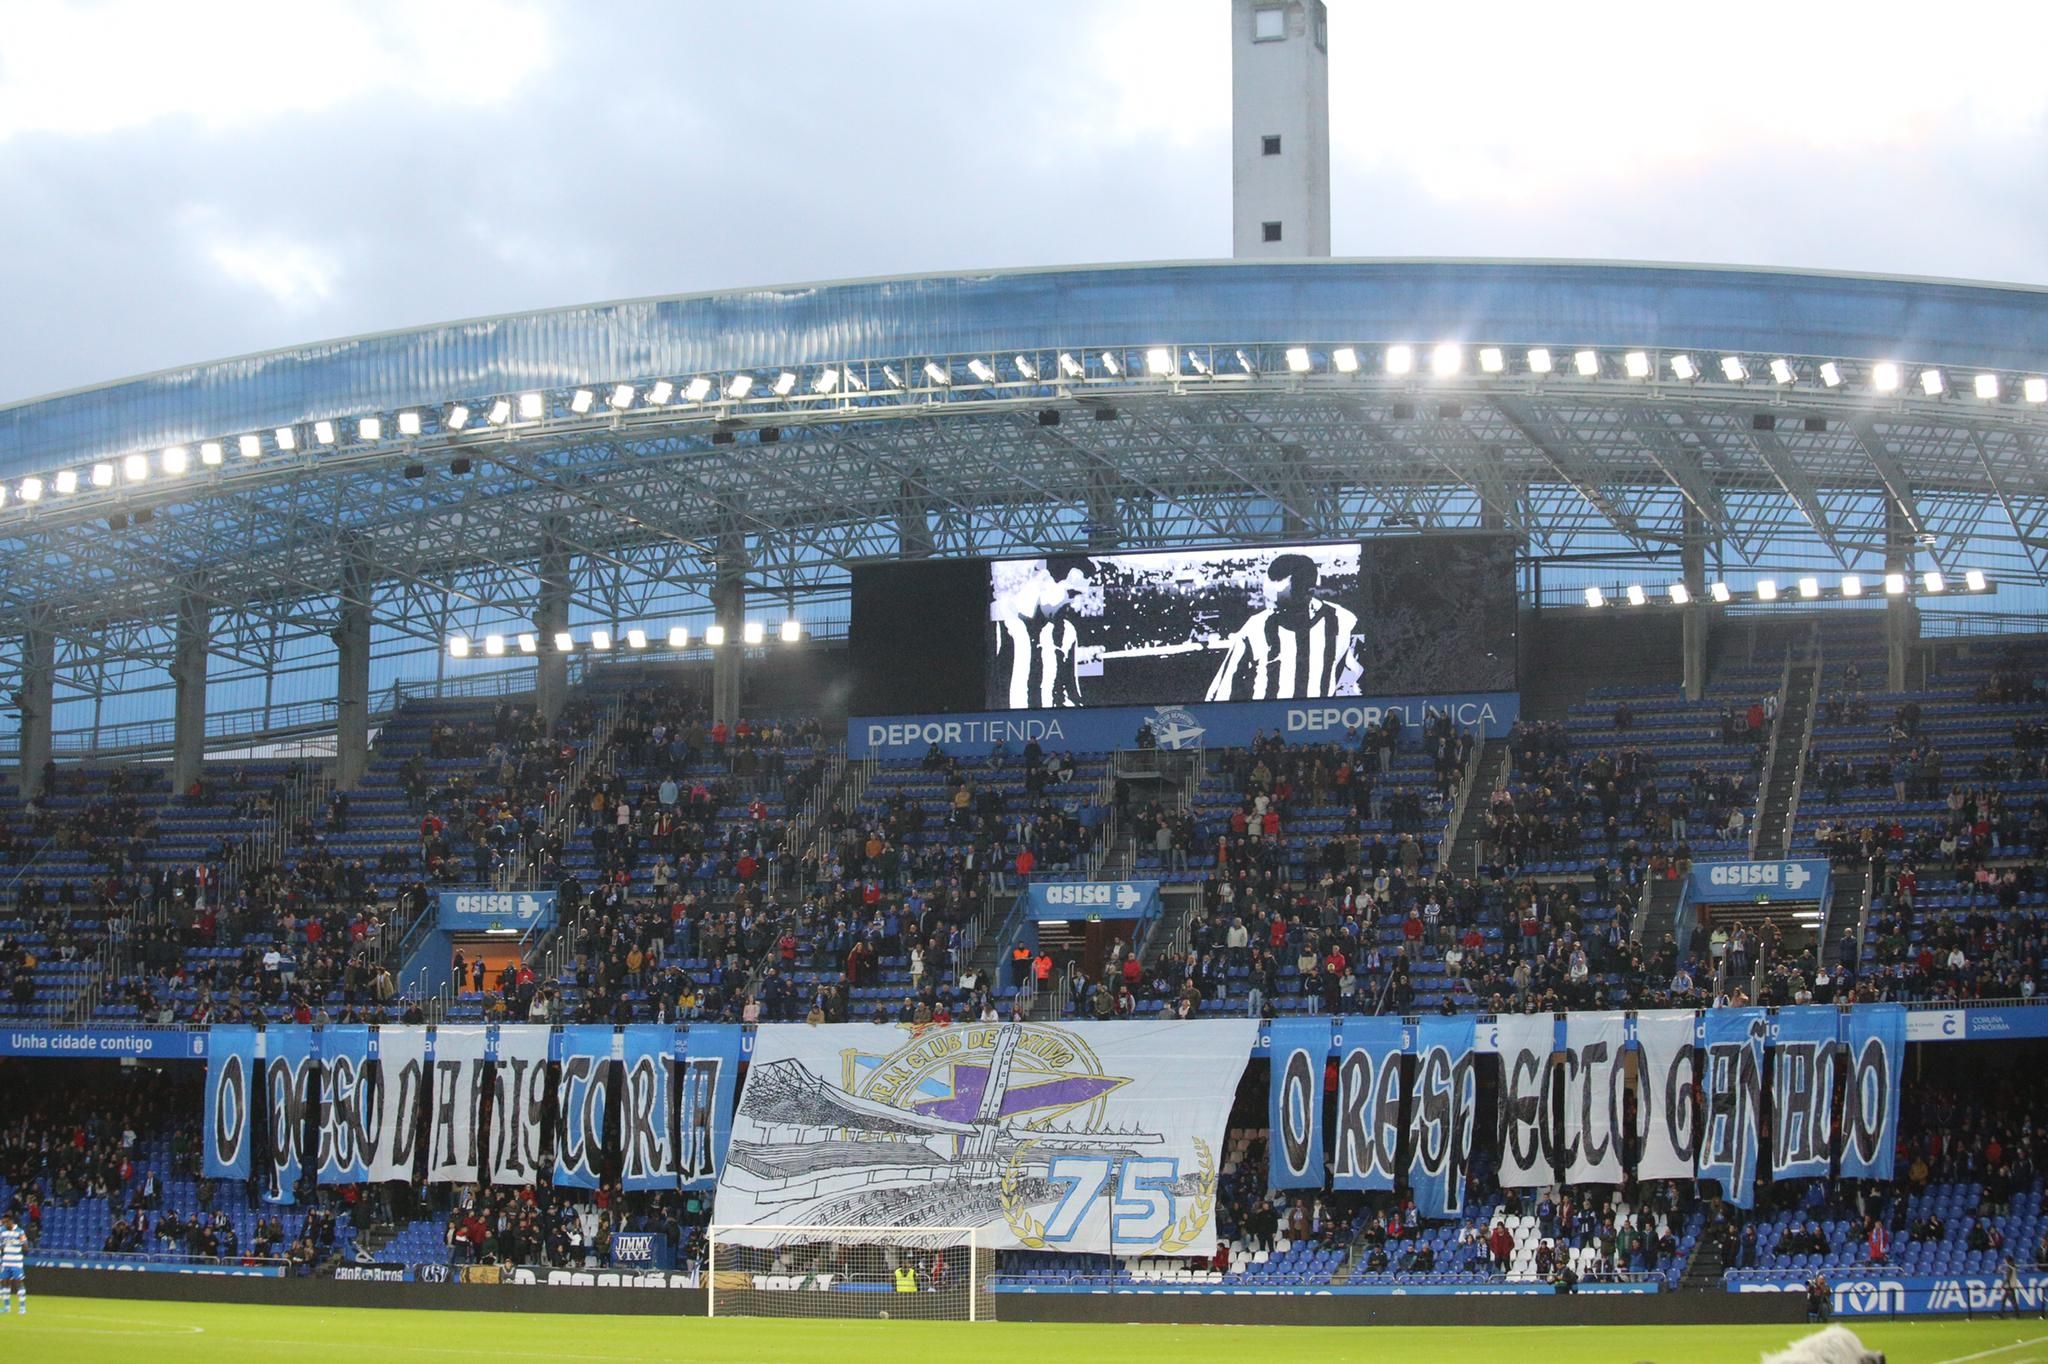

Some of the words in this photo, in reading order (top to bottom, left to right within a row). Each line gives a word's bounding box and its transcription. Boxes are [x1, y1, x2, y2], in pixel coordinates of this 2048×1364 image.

[1710, 864, 1779, 886] asisa
[456, 895, 512, 914] asisa
[1046, 885, 1111, 905] asisa
[12, 1034, 47, 1049] Unha
[51, 1034, 97, 1049] cidade
[100, 1035, 153, 1053] contigo
[905, 1034, 962, 1069] CLUB
[1044, 1155, 1180, 1244] 75
[615, 1236, 653, 1250] JIMMY
